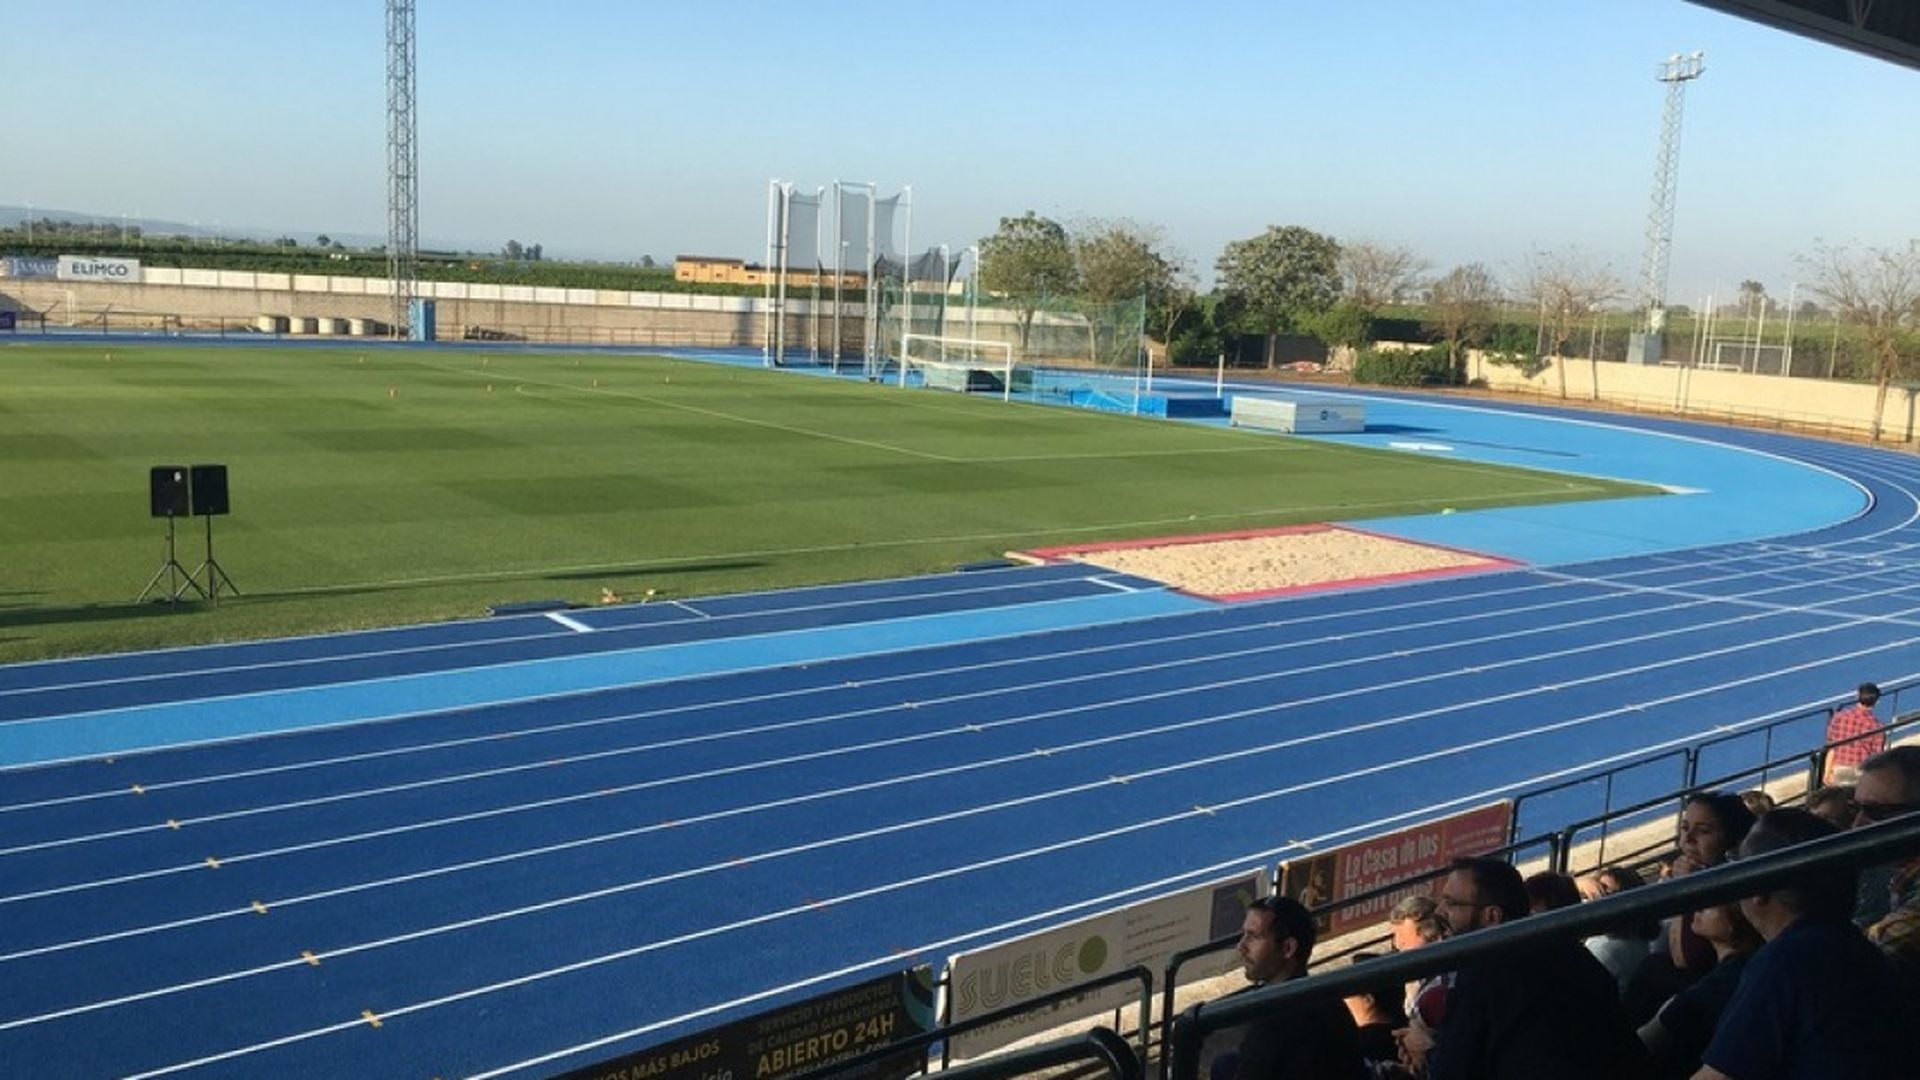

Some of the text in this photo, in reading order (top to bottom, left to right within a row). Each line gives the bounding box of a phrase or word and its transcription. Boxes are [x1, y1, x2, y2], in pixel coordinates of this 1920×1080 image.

[72, 262, 128, 276] ELIMCO
[1345, 853, 1361, 881] La
[1362, 846, 1398, 876] Casa
[1400, 837, 1416, 865] de
[1418, 833, 1439, 860] los
[671, 1039, 720, 1068] BAJOS
[756, 1028, 848, 1079] ABIERTO
[854, 1011, 894, 1043] 24H
